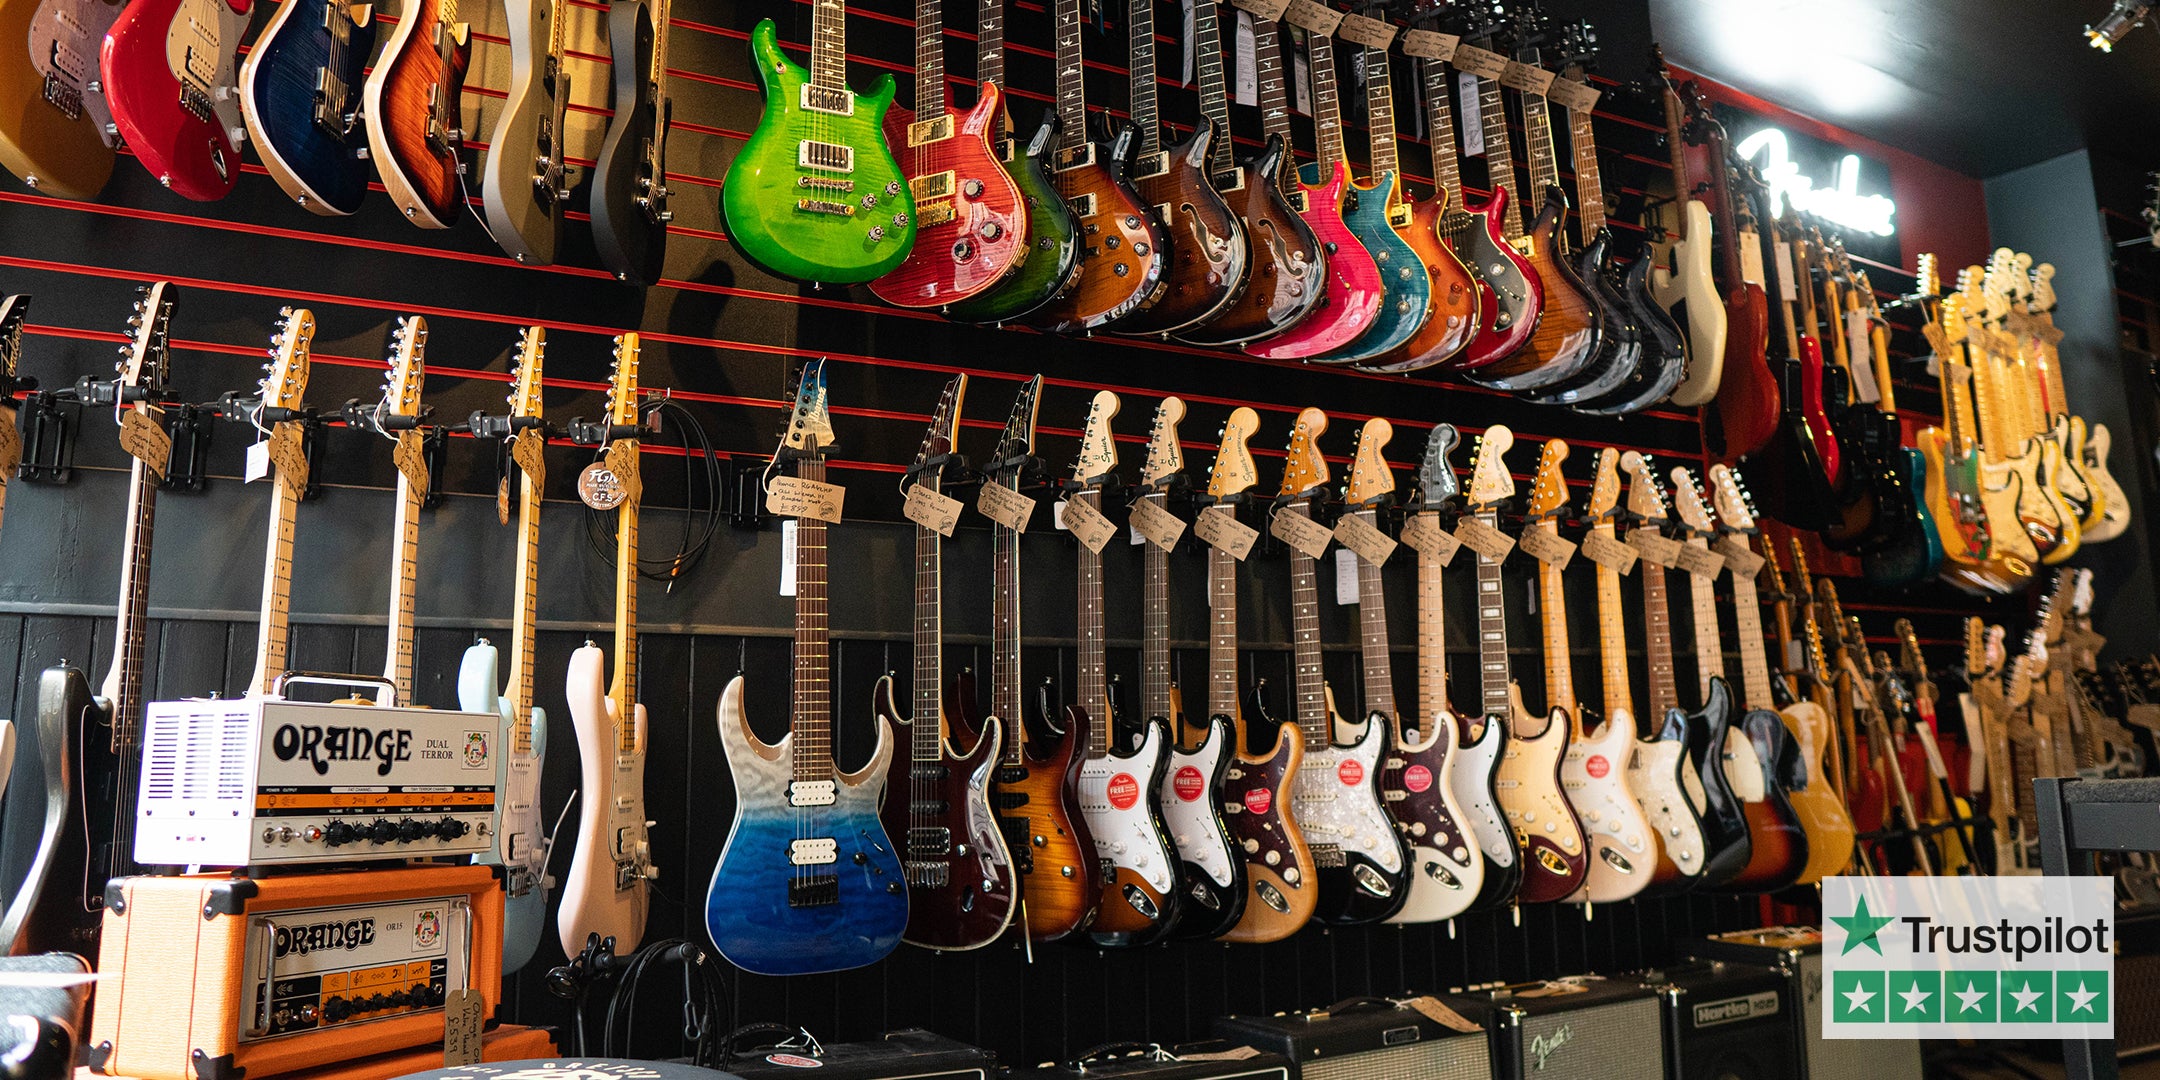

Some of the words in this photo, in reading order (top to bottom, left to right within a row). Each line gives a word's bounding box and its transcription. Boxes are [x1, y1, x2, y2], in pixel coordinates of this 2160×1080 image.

[808, 386, 827, 423] Ibanez
[1101, 436, 1111, 463] Squier
[1168, 441, 1178, 467] Squier
[589, 469, 619, 484] FGN
[1242, 456, 1254, 482] Squier
[273, 723, 413, 776] ORANGE
[420, 750, 454, 760] TERROR
[426, 739, 450, 749] DUAL
[1110, 786, 1125, 795] FREE
[1176, 778, 1190, 786] FREE
[275, 918, 375, 959] ORANGE
[385, 922, 403, 932] OR15
[469, 1002, 480, 1038] Orange
[1698, 1001, 1749, 1022] Hartke
[447, 1016, 459, 1053] £539
[1530, 1023, 1574, 1070] Fender
